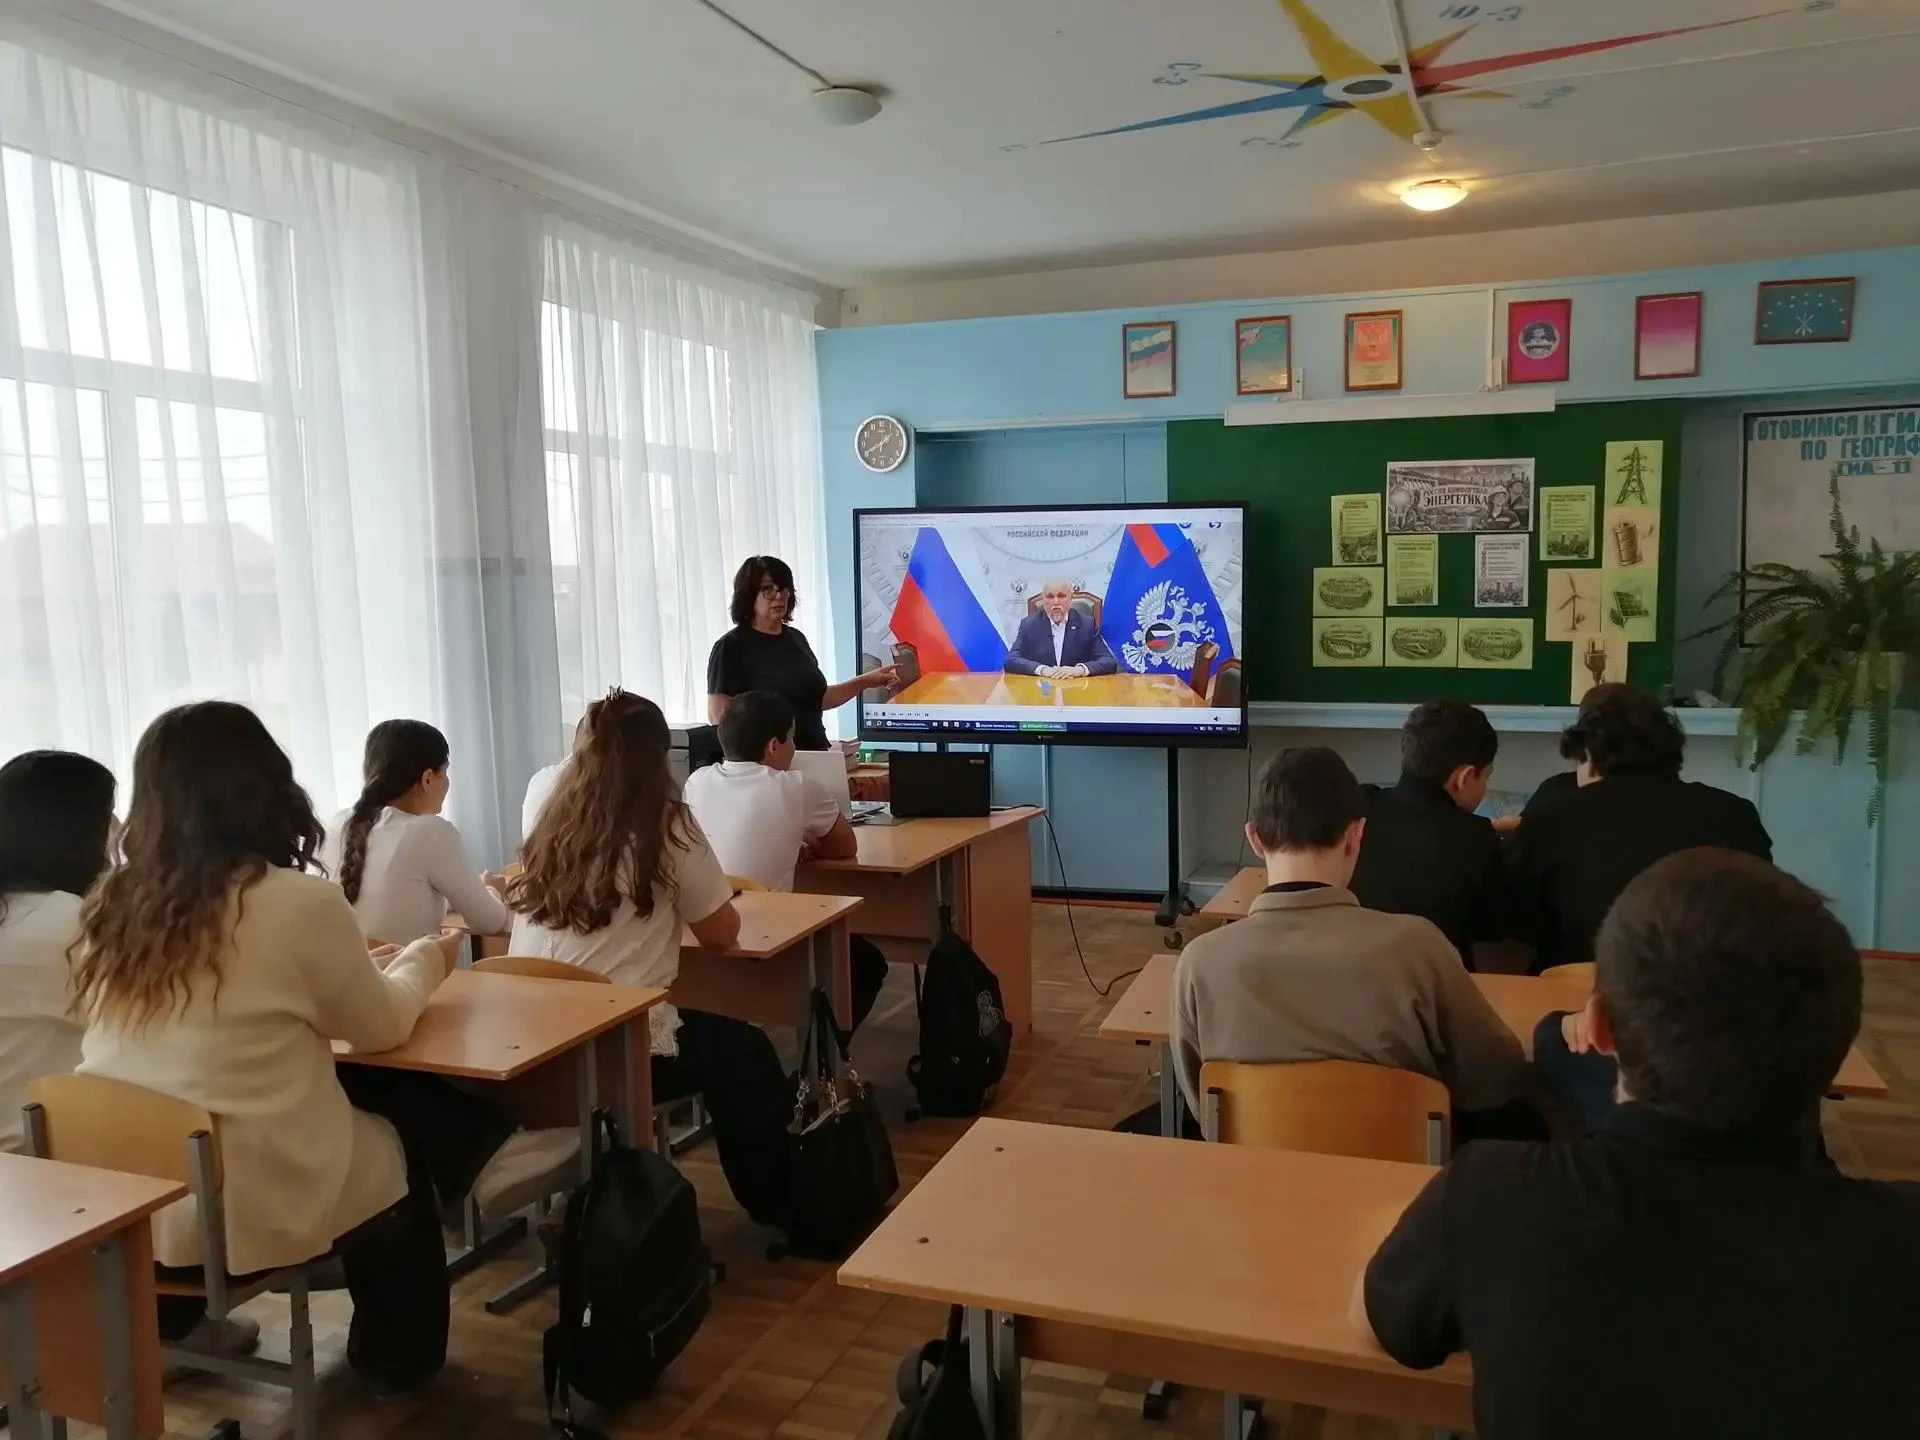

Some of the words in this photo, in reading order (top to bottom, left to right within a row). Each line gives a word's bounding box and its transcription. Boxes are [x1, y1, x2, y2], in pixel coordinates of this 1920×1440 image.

[1800, 439, 1827, 460] ПО
[1837, 460, 1874, 476] ГИА
[1423, 494, 1489, 507] ЭНЕРГЕТИКА
[1006, 528, 1048, 538] РОССИЙСКОЙ
[1049, 528, 1089, 538] ФЕДЕРАЦИИ
